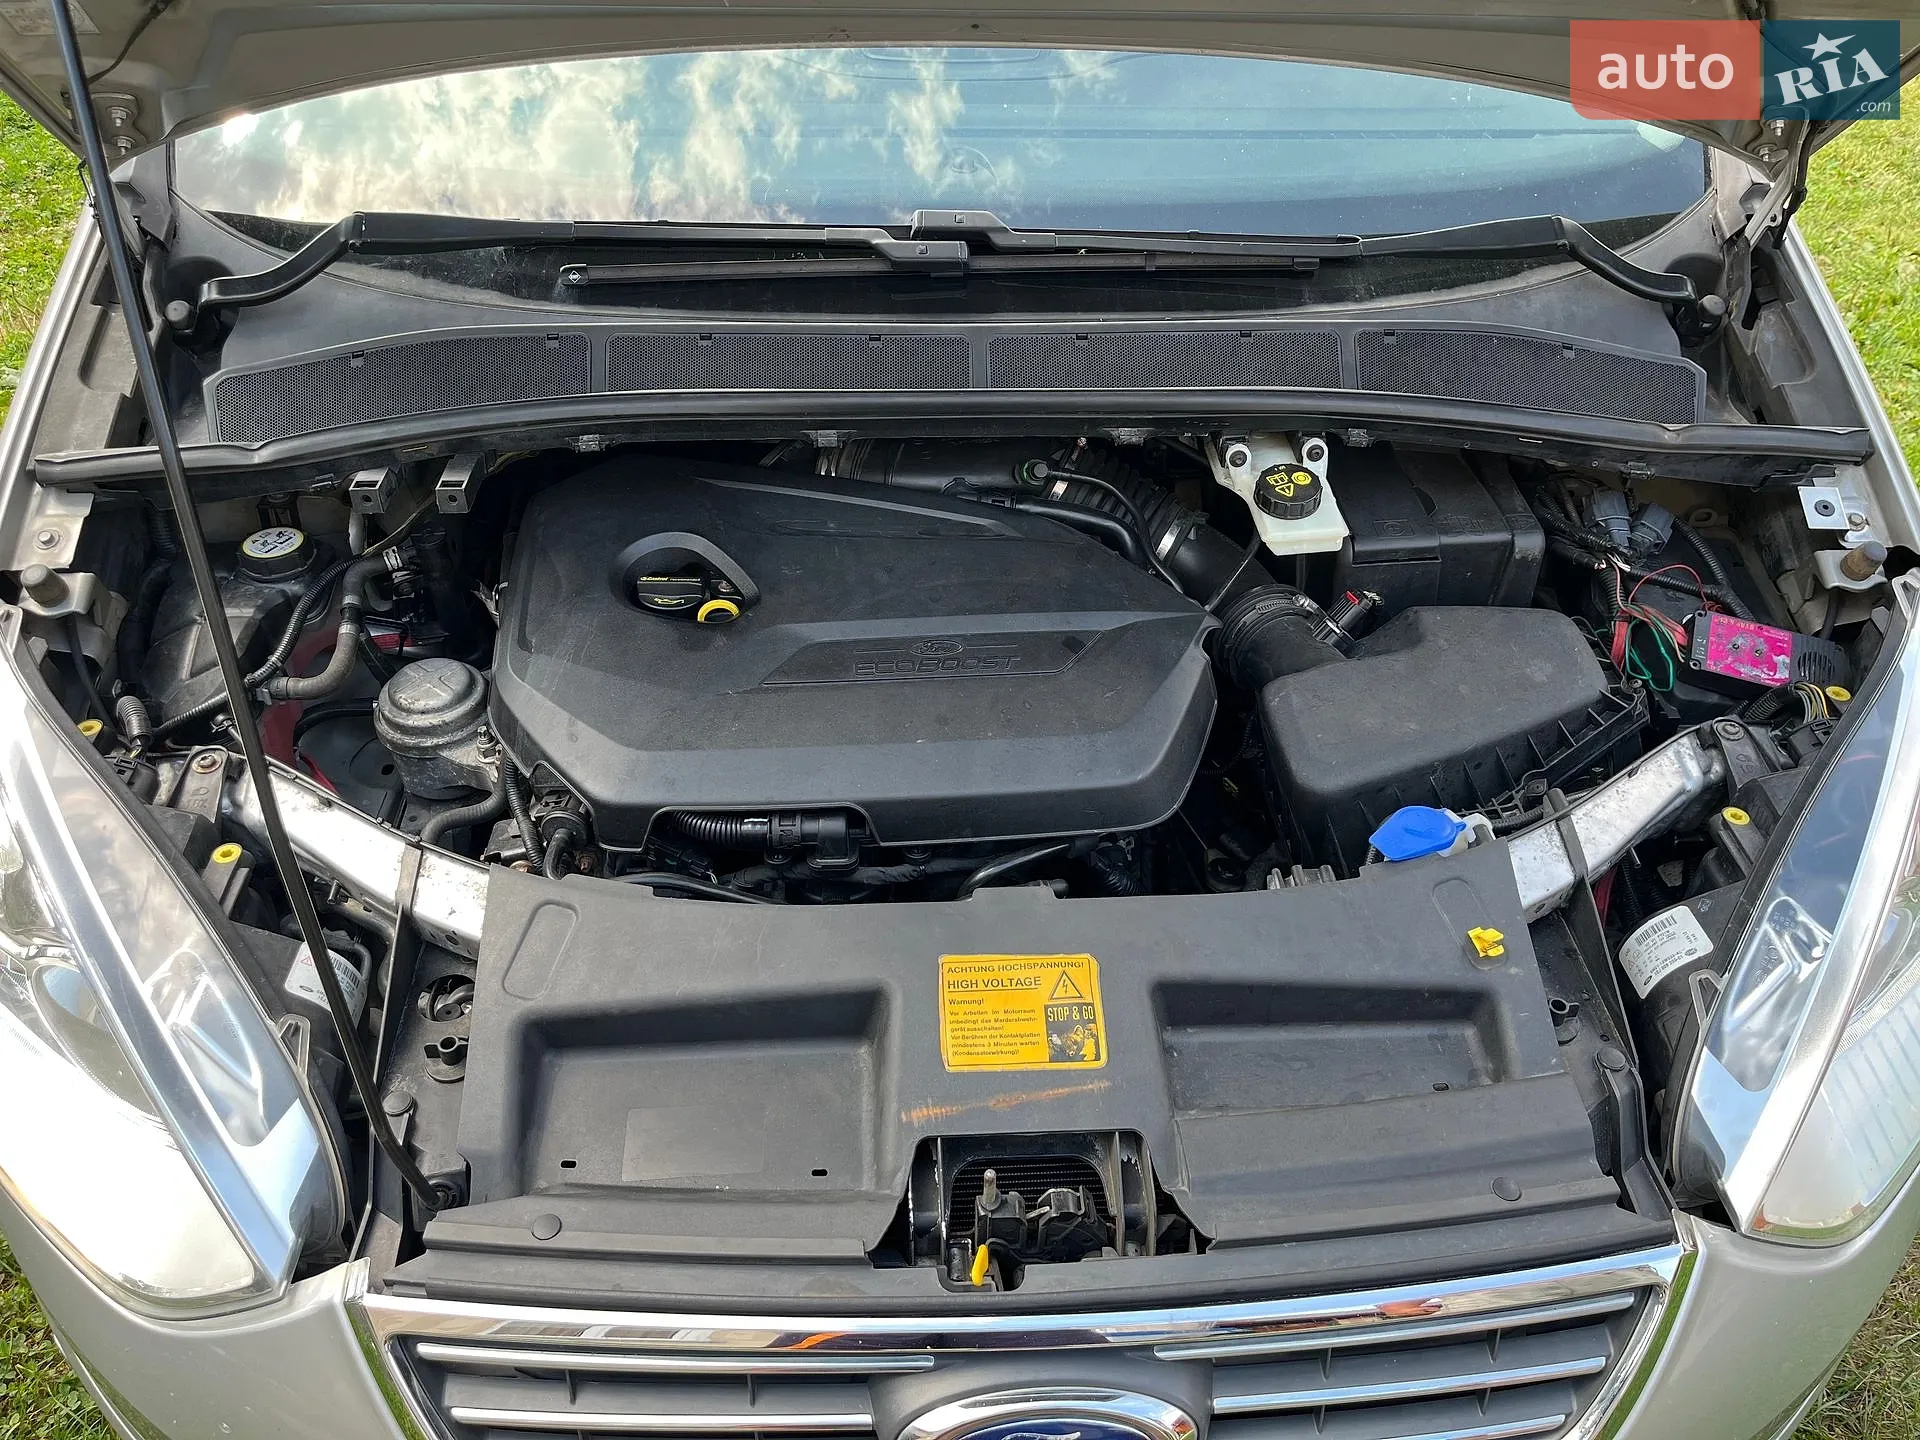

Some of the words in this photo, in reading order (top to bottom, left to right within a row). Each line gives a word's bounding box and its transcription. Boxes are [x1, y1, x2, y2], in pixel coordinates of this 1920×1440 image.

[947, 965, 995, 974] ACHTUNG
[998, 961, 1084, 972] HOCHSPANNUNG!
[947, 979, 979, 990] HIGH
[983, 976, 1042, 988] VOLTAGE
[948, 998, 984, 1006] Warnung!
[1047, 1006, 1069, 1021] STOP
[1072, 1005, 1080, 1020] &
[1082, 1005, 1095, 1019] GO
